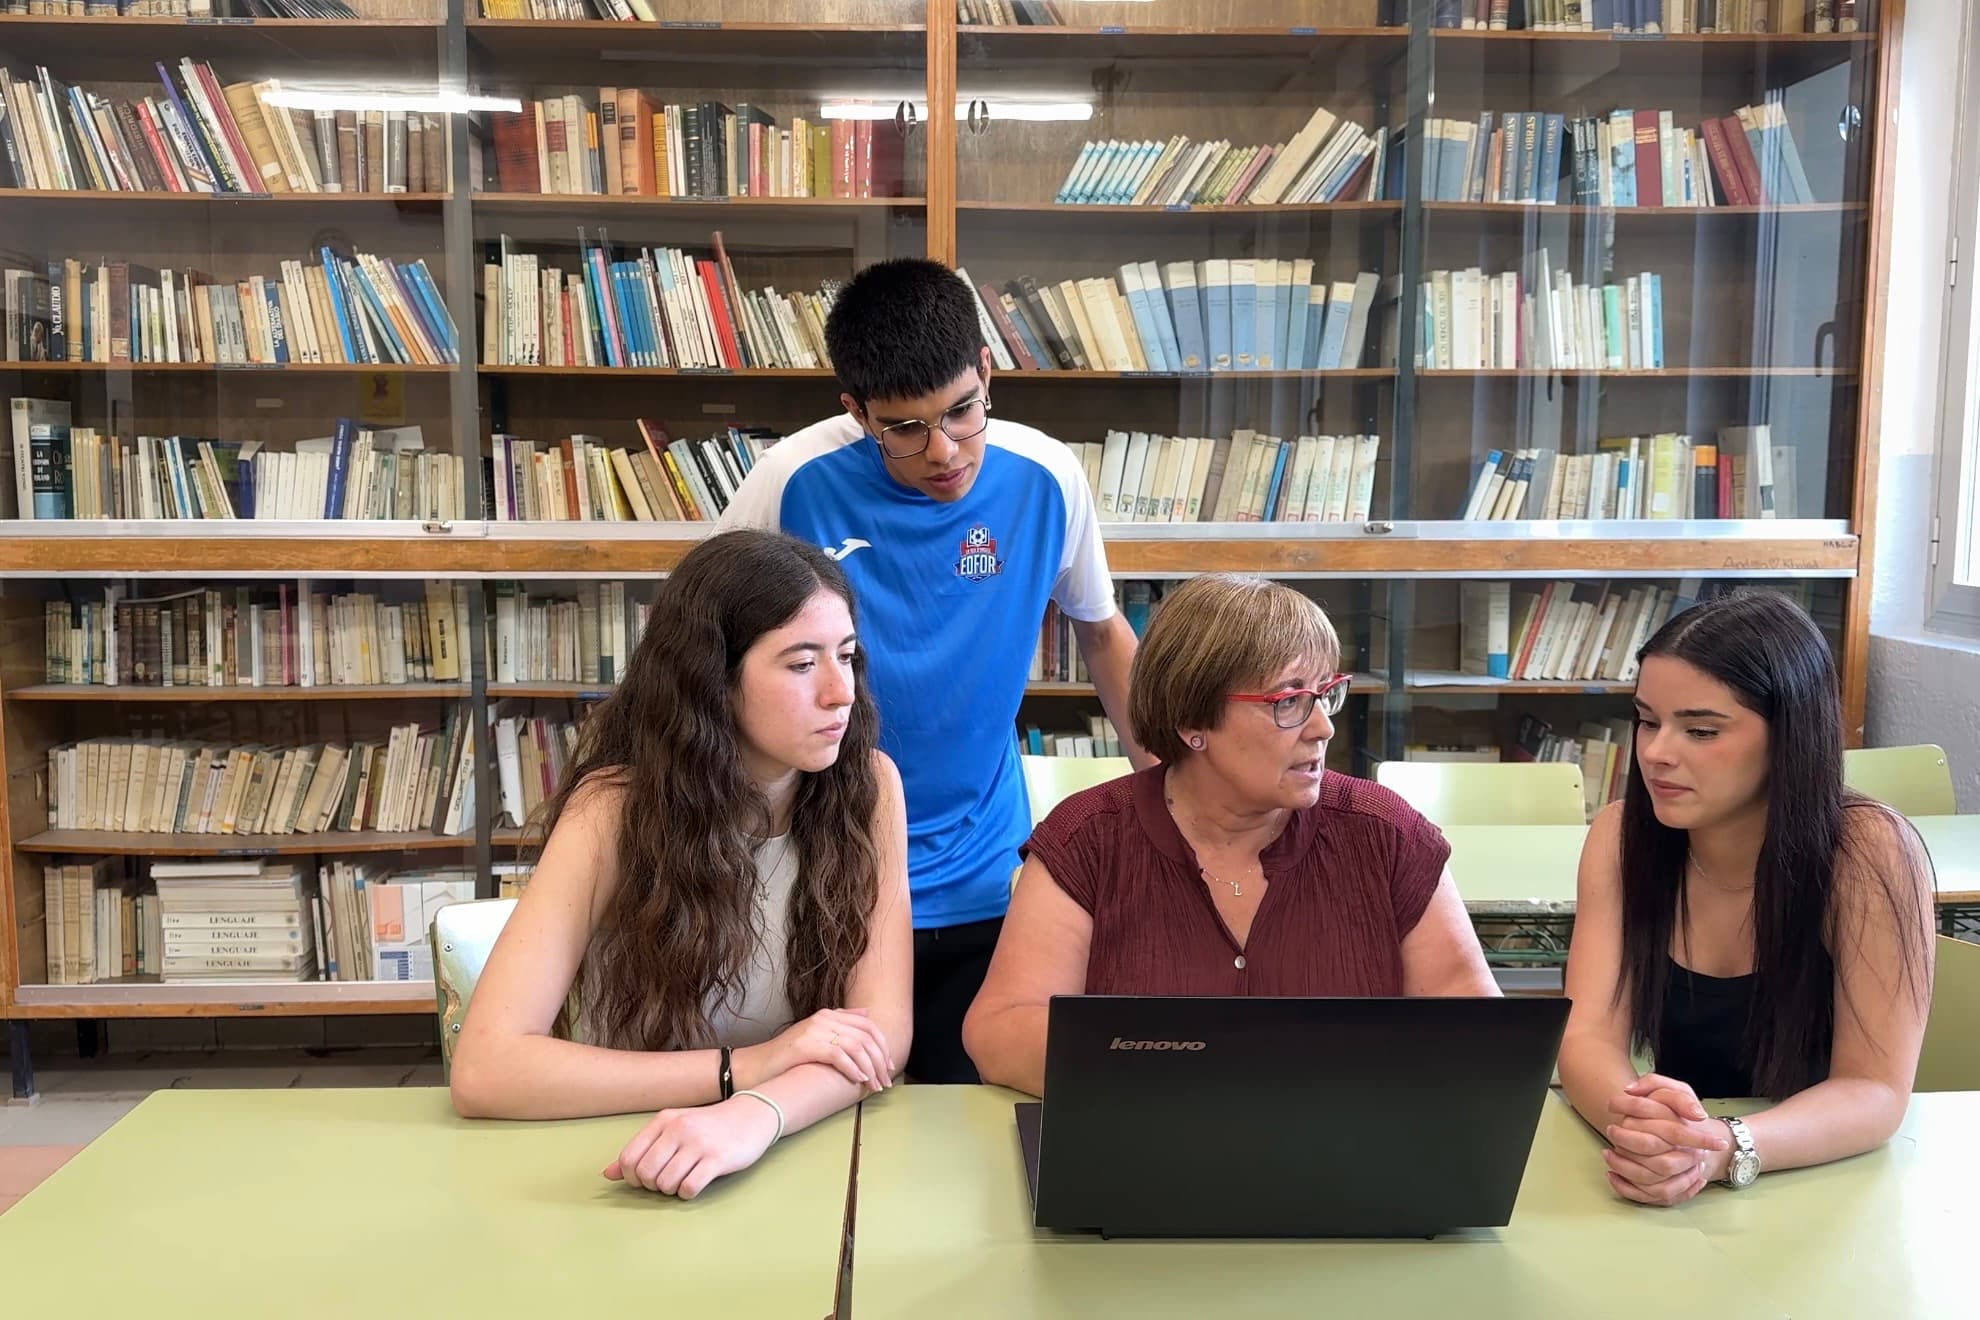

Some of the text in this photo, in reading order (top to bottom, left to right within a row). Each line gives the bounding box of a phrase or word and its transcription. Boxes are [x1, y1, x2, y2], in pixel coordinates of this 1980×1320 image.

[1506, 117, 1516, 151] OBRAS
[1525, 115, 1536, 150] OBRAS
[51, 286, 62, 323] CLAUDIO
[209, 916, 257, 924] LENGUAJE
[211, 931, 257, 939] LENGUAJE
[210, 946, 257, 954] LENGUAJE
[206, 960, 251, 968] LENGUAJE
[1110, 1037, 1206, 1051] lenovo
